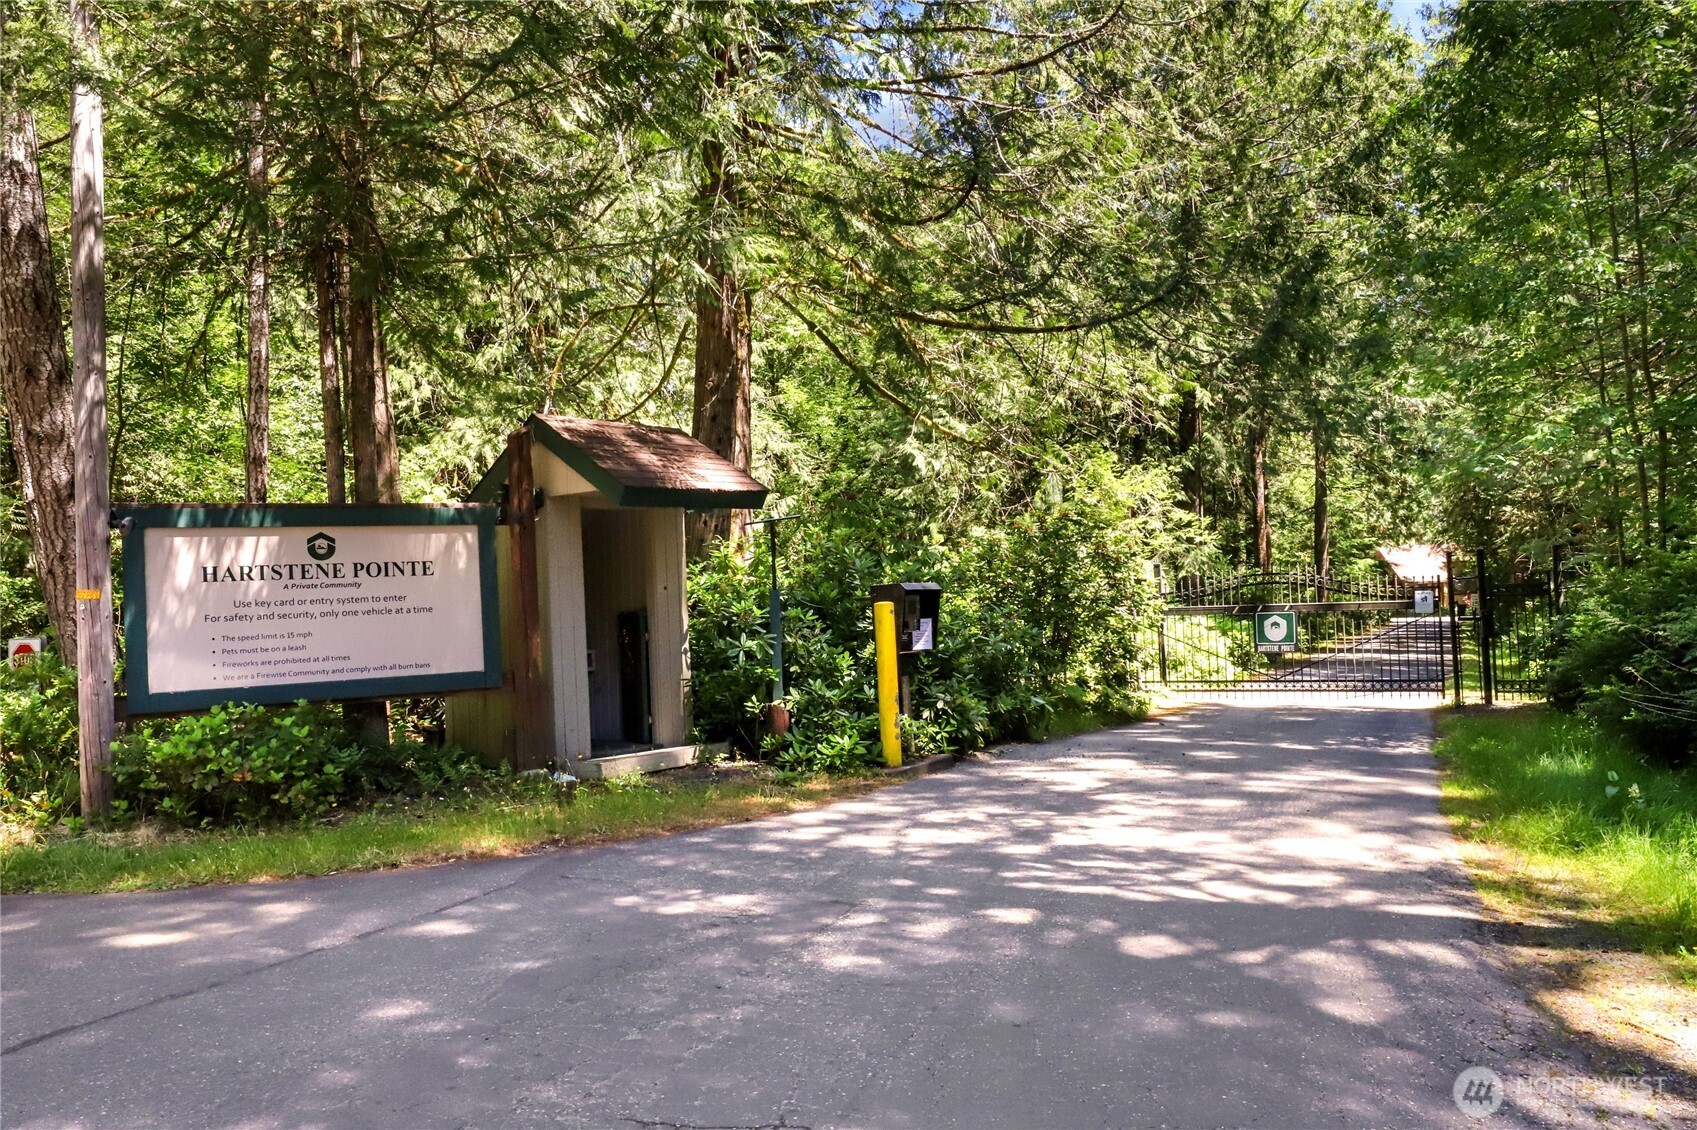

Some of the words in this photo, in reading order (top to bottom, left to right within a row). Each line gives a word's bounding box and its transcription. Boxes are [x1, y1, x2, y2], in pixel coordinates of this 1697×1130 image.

[201, 563, 346, 583] HARTSTENE
[352, 561, 435, 578] POINTE
[319, 582, 363, 590] Community
[233, 600, 252, 608] Use
[255, 599, 272, 609] key
[274, 598, 295, 607] card
[309, 596, 335, 607] entry
[336, 595, 370, 606] system
[371, 595, 381, 603] to
[383, 594, 407, 603] enter
[204, 614, 221, 623] For
[223, 613, 254, 623] safety
[256, 612, 275, 621] and
[277, 610, 318, 620] security,
[319, 609, 340, 619] only
[361, 607, 393, 616] vehicle
[394, 607, 404, 615] at
[413, 606, 434, 614] time
[237, 634, 260, 642] speed
[296, 631, 313, 639] mph
[273, 657, 311, 666] prohibited
[287, 668, 329, 676] Community
[345, 665, 372, 673] comply
